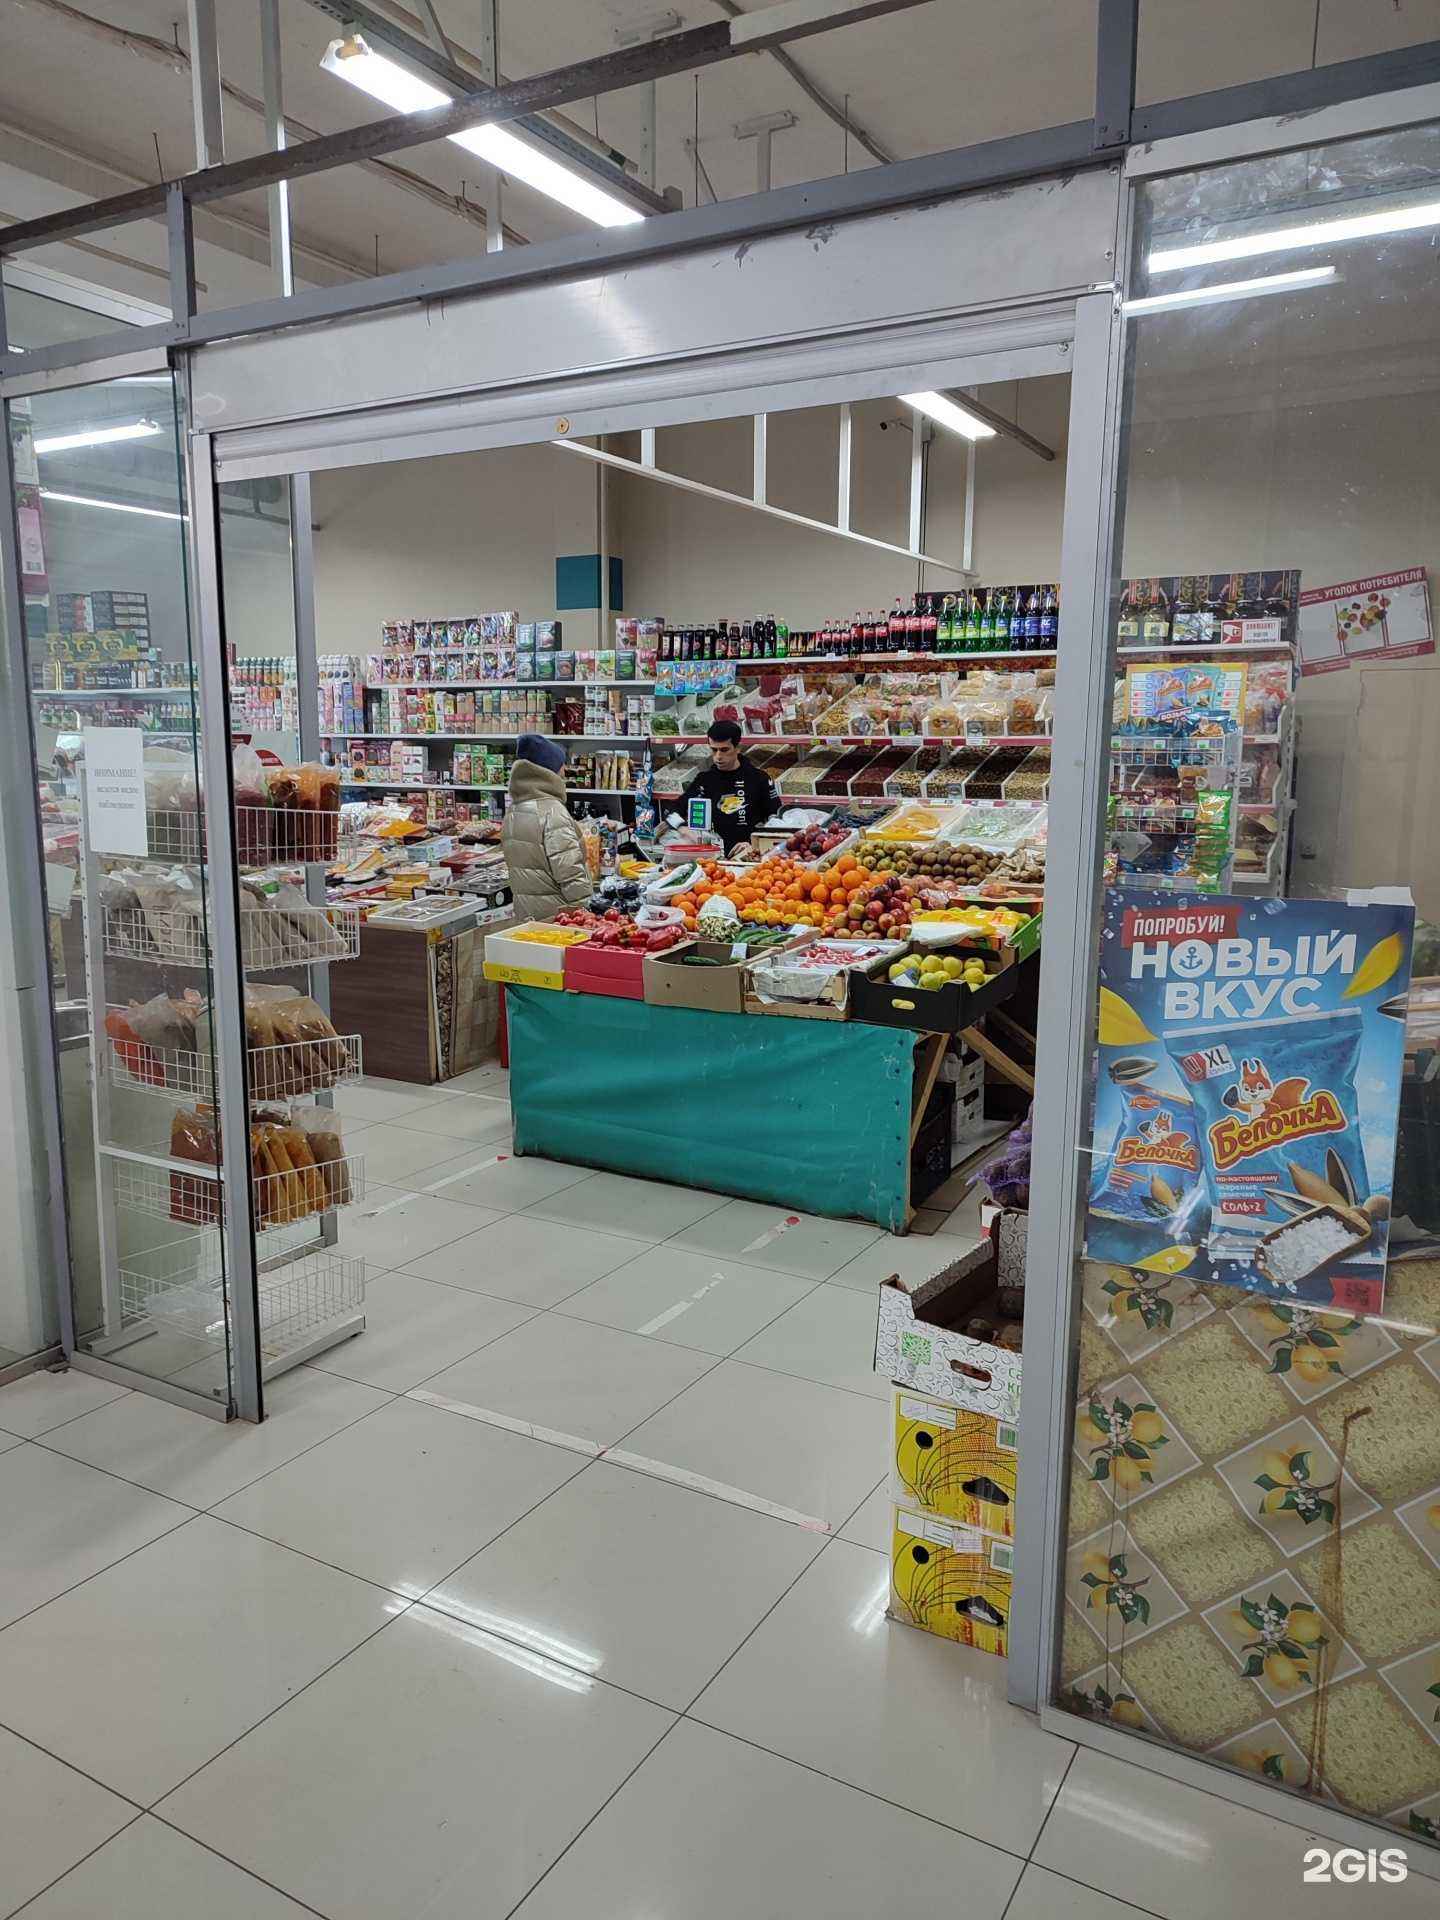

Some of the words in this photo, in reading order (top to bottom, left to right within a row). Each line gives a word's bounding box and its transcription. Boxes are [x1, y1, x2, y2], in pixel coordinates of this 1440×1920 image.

[1324, 584, 1358, 599] УГОЛОК
[1359, 570, 1423, 592] ПОТРЕБИТЕЛЯ
[1133, 914, 1226, 937] ПОПРОБУЙ!
[1130, 929, 1357, 979] НОВЫЙ
[1164, 976, 1322, 1020] ВКУС
[1204, 1048, 1230, 1068] XL
